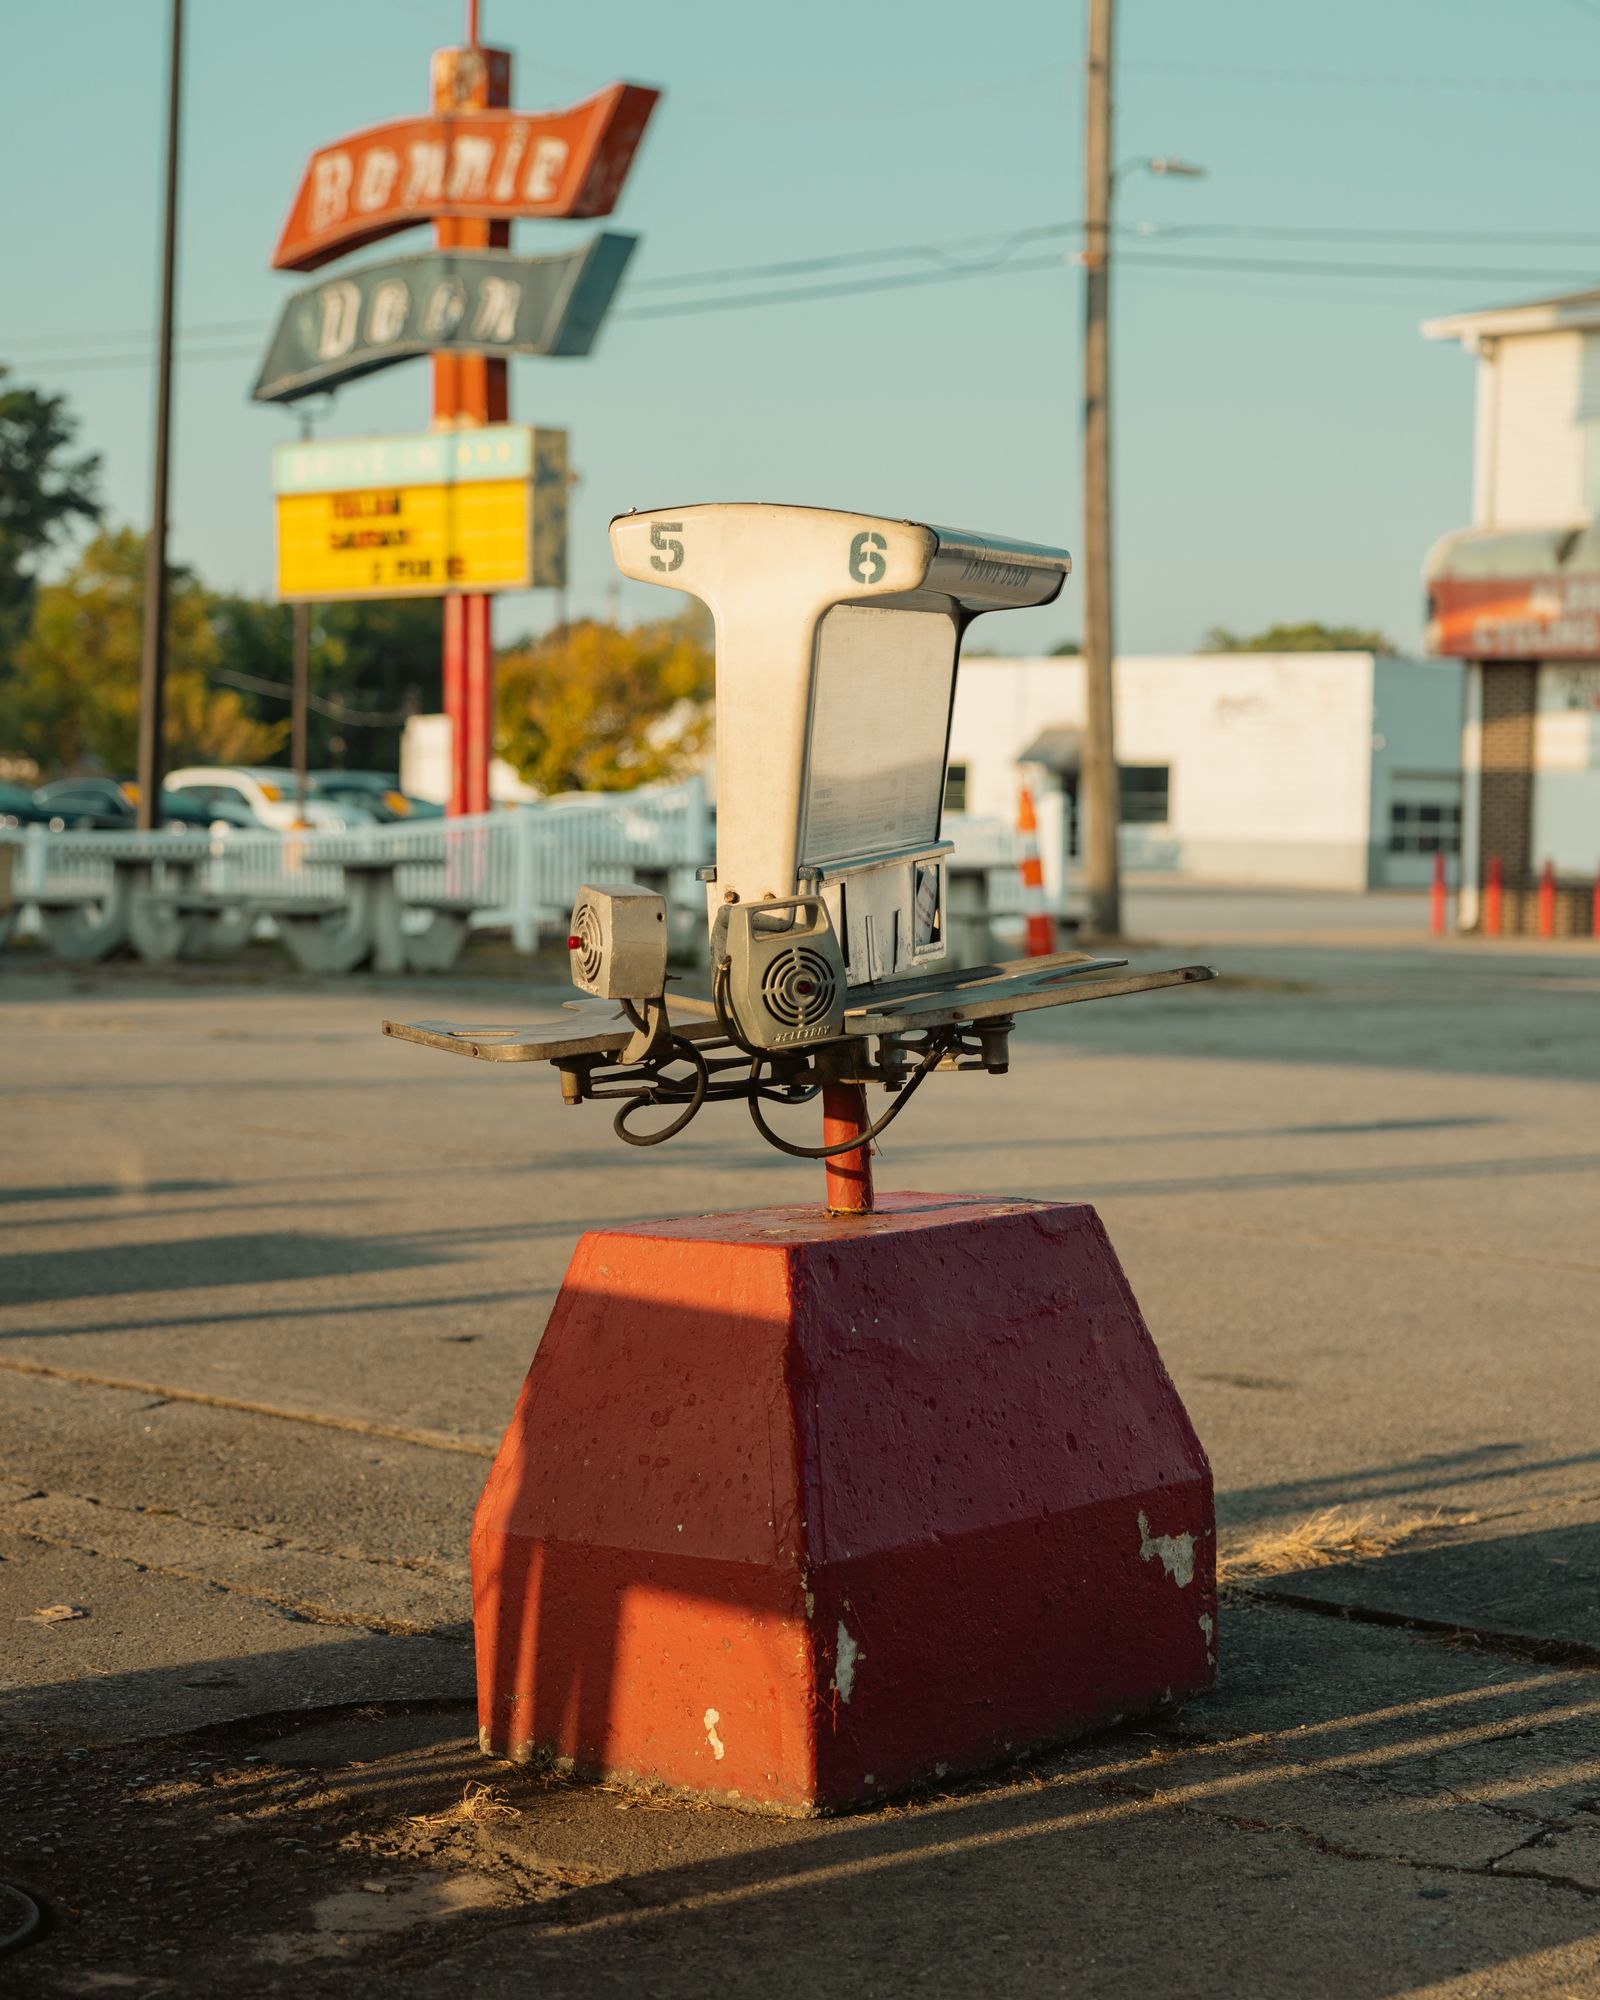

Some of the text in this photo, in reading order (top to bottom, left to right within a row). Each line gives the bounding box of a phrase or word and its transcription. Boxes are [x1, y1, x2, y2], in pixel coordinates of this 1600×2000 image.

[317, 275, 521, 360] DOON
[649, 521, 685, 573] 5
[848, 531, 887, 585] 6
[999, 566, 1033, 589] DOON
